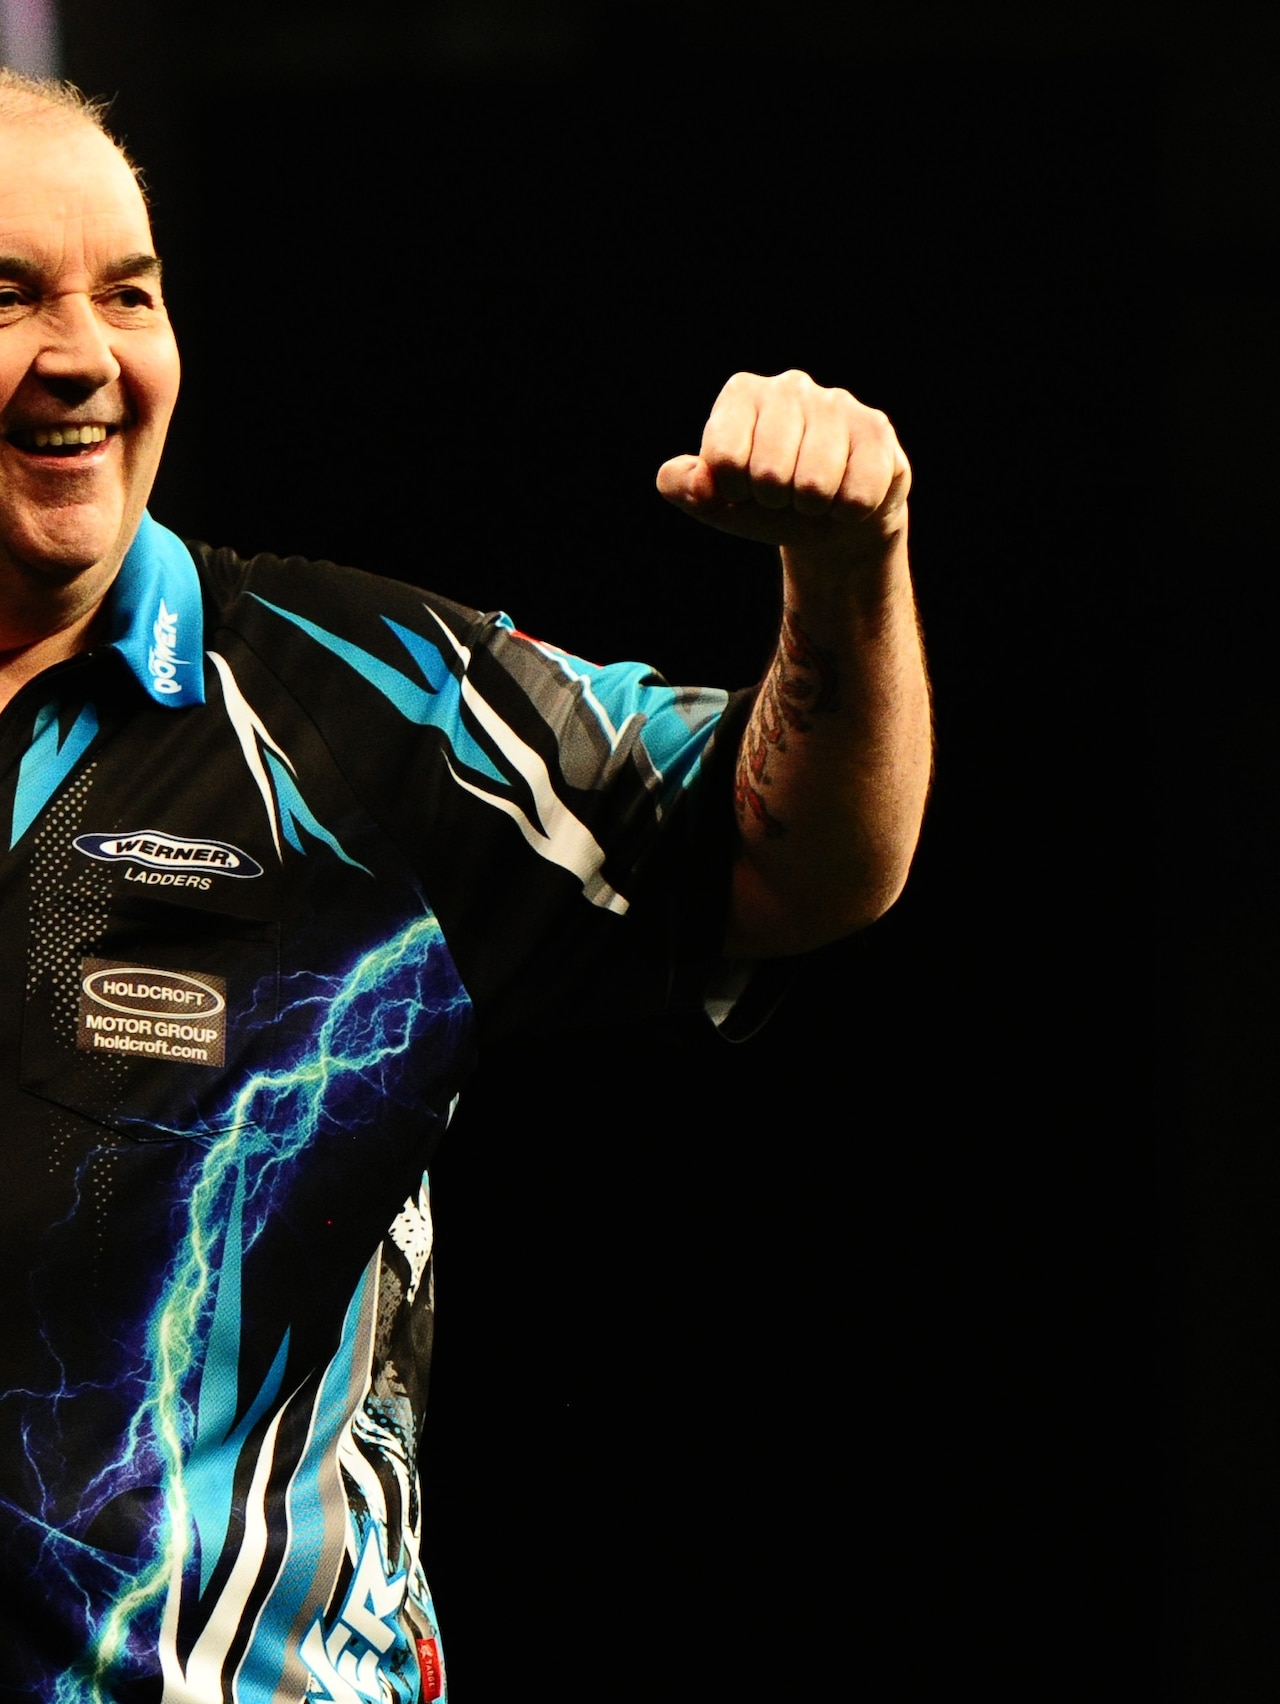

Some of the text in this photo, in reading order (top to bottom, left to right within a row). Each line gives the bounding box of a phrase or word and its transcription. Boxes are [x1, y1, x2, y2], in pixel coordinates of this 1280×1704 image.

[115, 839, 231, 866] WERNER
[124, 867, 212, 891] LADDERS
[102, 980, 205, 1006] HOLDCROFT
[85, 1014, 218, 1044] MOTOR GROUP
[93, 1032, 208, 1061] holdcroft.com
